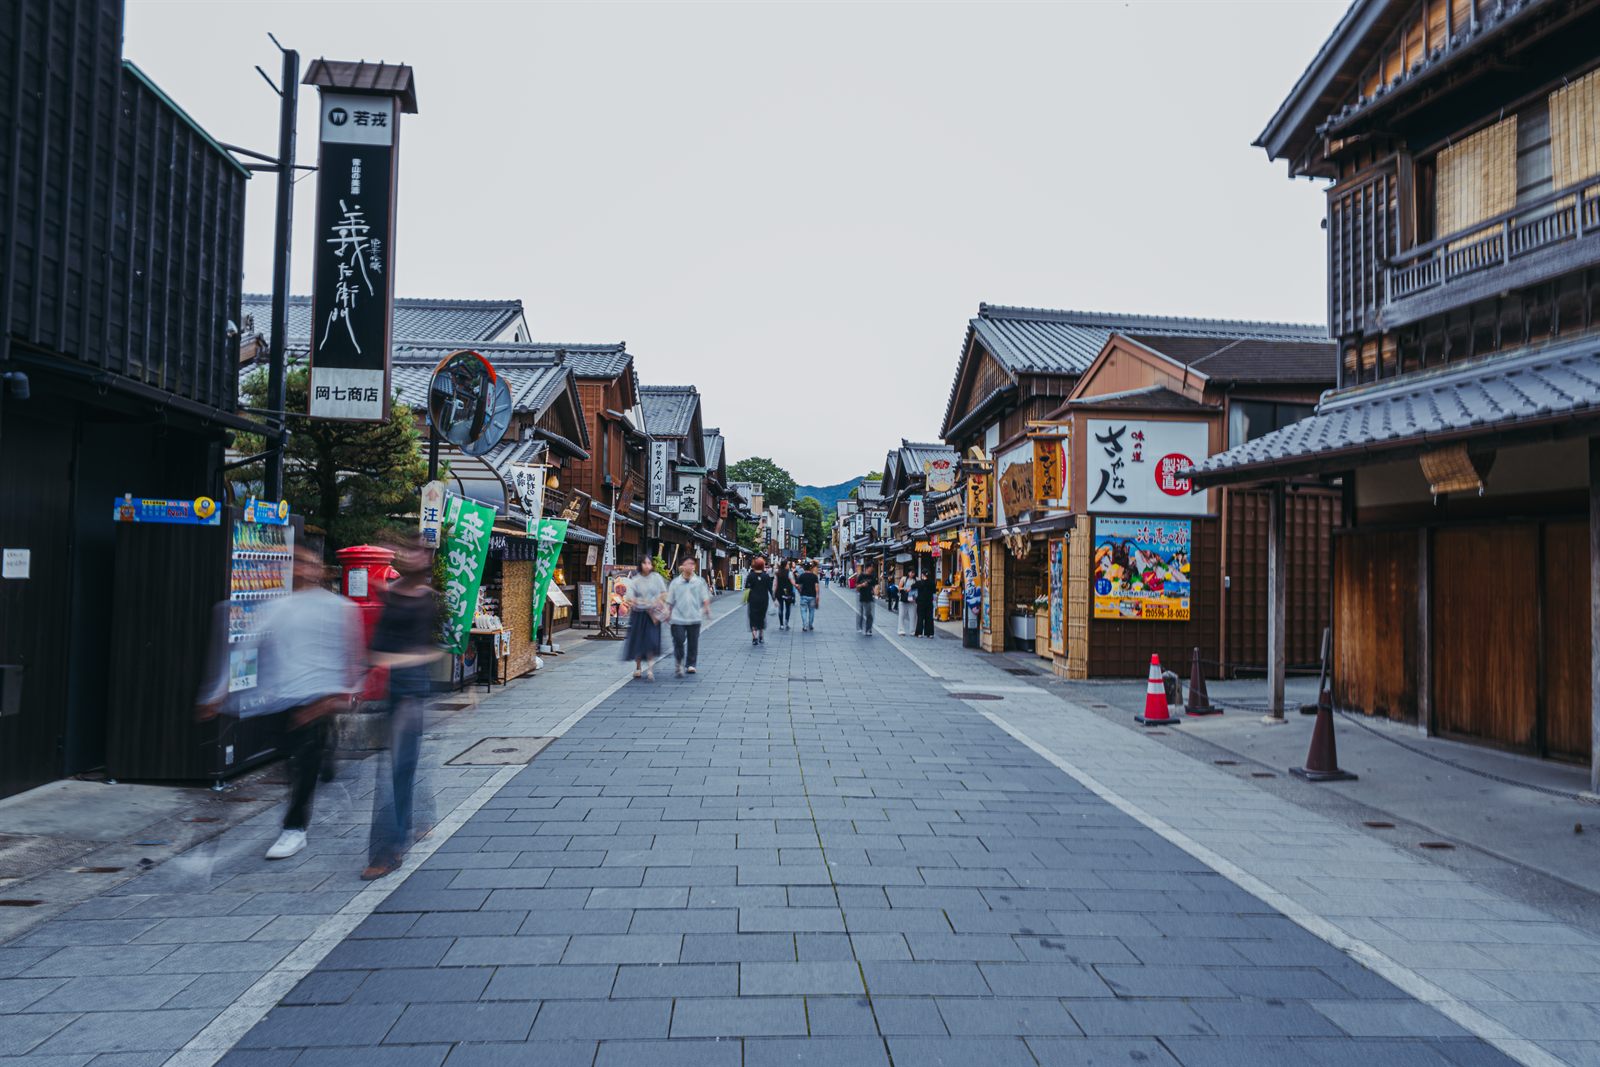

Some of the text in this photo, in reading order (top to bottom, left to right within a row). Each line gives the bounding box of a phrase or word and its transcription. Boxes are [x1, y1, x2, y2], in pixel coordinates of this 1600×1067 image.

[353, 111, 388, 127] 若戎
[315, 385, 379, 402] 岡七商店
[1131, 430, 1145, 463] 味の道
[423, 507, 438, 543] 注意
